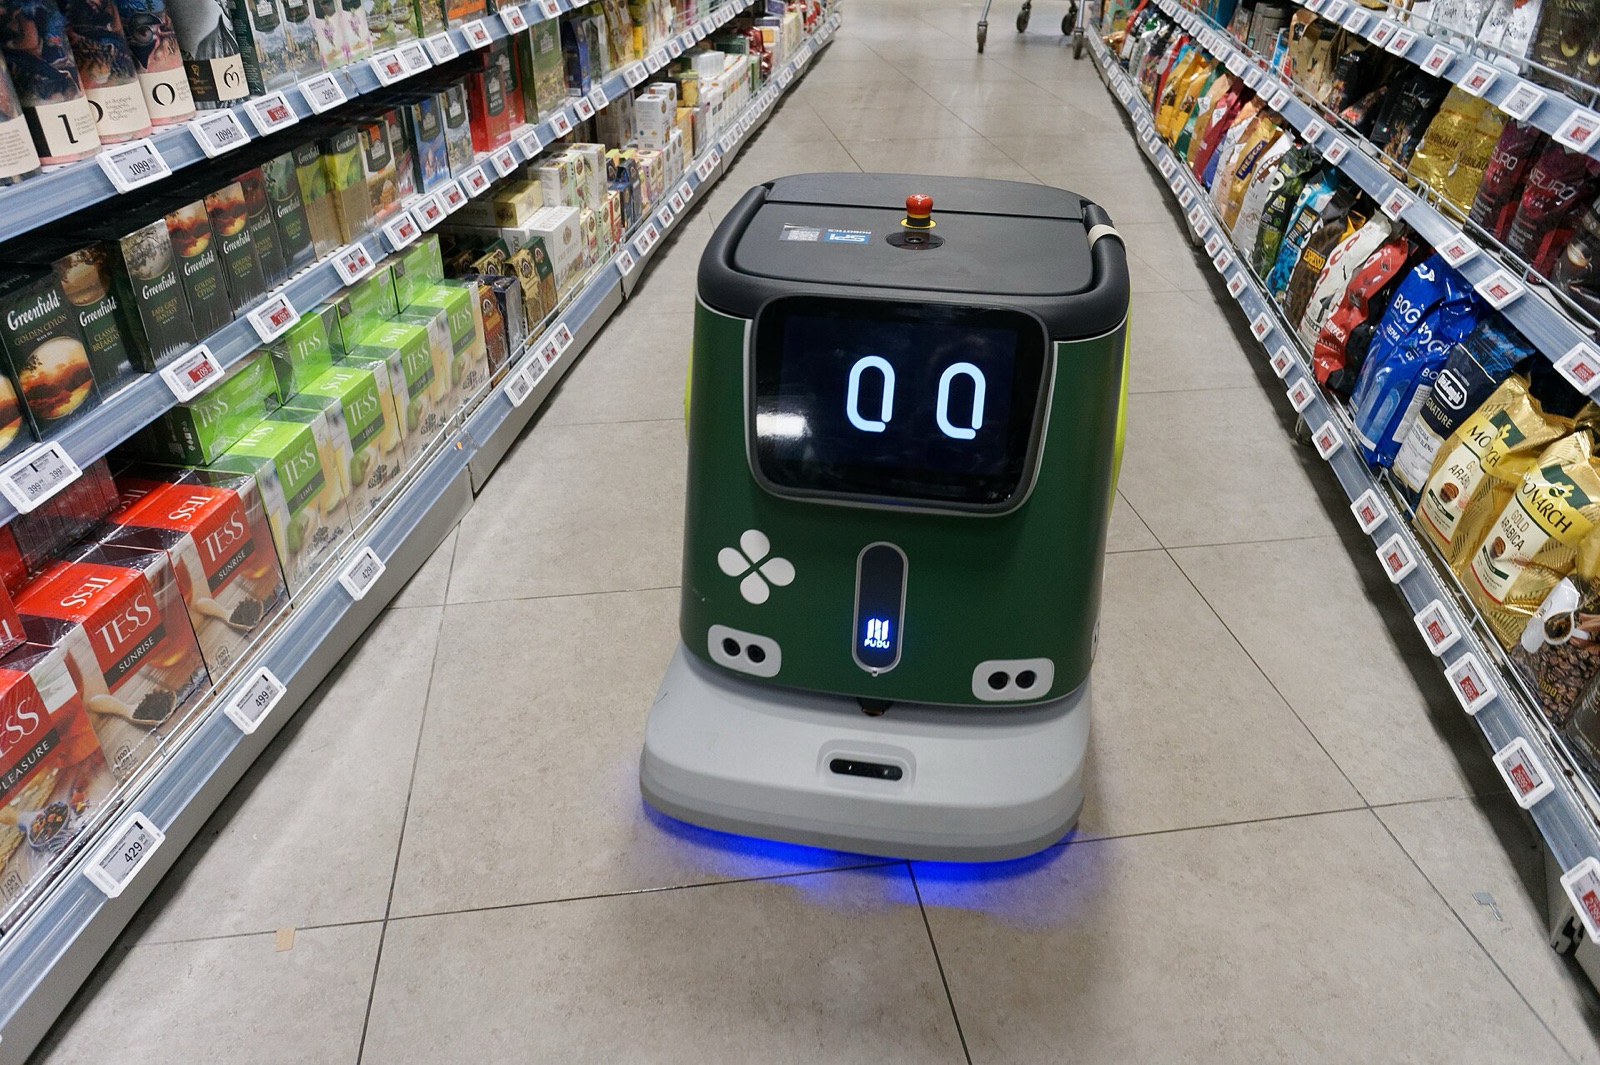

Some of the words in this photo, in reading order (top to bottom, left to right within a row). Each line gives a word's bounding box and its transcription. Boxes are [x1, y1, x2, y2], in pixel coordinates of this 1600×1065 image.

[216, 129, 232, 143] 1099
[129, 159, 150, 176] 1099
[223, 231, 251, 254] Greenfield
[184, 250, 215, 276] Greenfield
[142, 272, 176, 300] Greenfield
[7, 289, 61, 331] Greenfield
[80, 296, 118, 327] Greenfield
[406, 340, 429, 375] TESS
[197, 367, 208, 379] 109
[347, 386, 378, 426] TESS
[49, 468, 61, 480] 399
[282, 442, 316, 487] TESS
[28, 482, 40, 495] 399
[168, 495, 216, 521] TESS
[1511, 509, 1530, 533] GOLD
[201, 511, 244, 556] TESS
[218, 550, 247, 580] SUNRISE
[362, 567, 373, 579] 429
[60, 575, 117, 609] TESS
[95, 592, 152, 654] TESS
[118, 636, 155, 672] SUNRISE
[864, 638, 890, 649] PUDU
[255, 690, 269, 707] 499
[0, 741, 50, 795] LEASURE
[124, 842, 143, 864] 429
